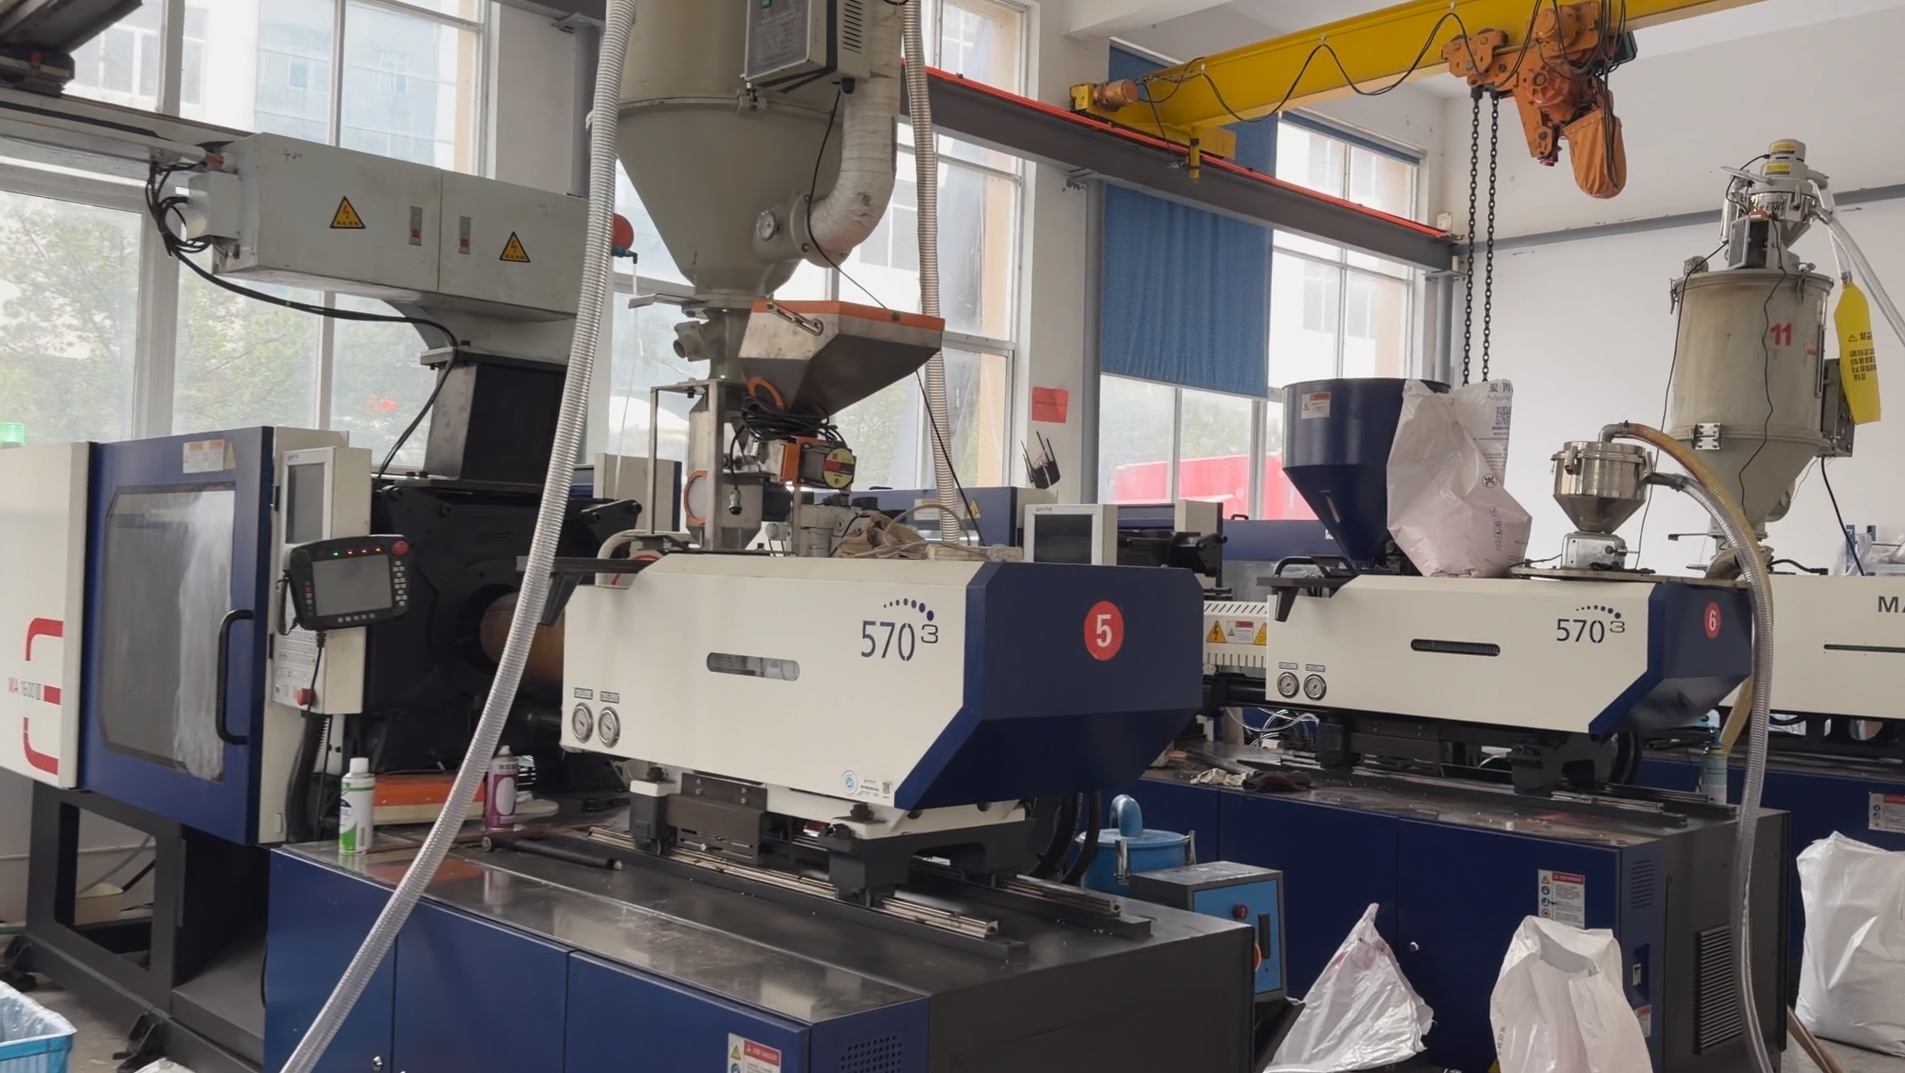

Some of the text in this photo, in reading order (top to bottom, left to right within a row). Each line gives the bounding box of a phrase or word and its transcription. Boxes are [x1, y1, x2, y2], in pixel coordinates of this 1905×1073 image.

[1770, 322, 1792, 346] 11
[1096, 614, 1112, 648] 5
[1709, 610, 1717, 631] 6
